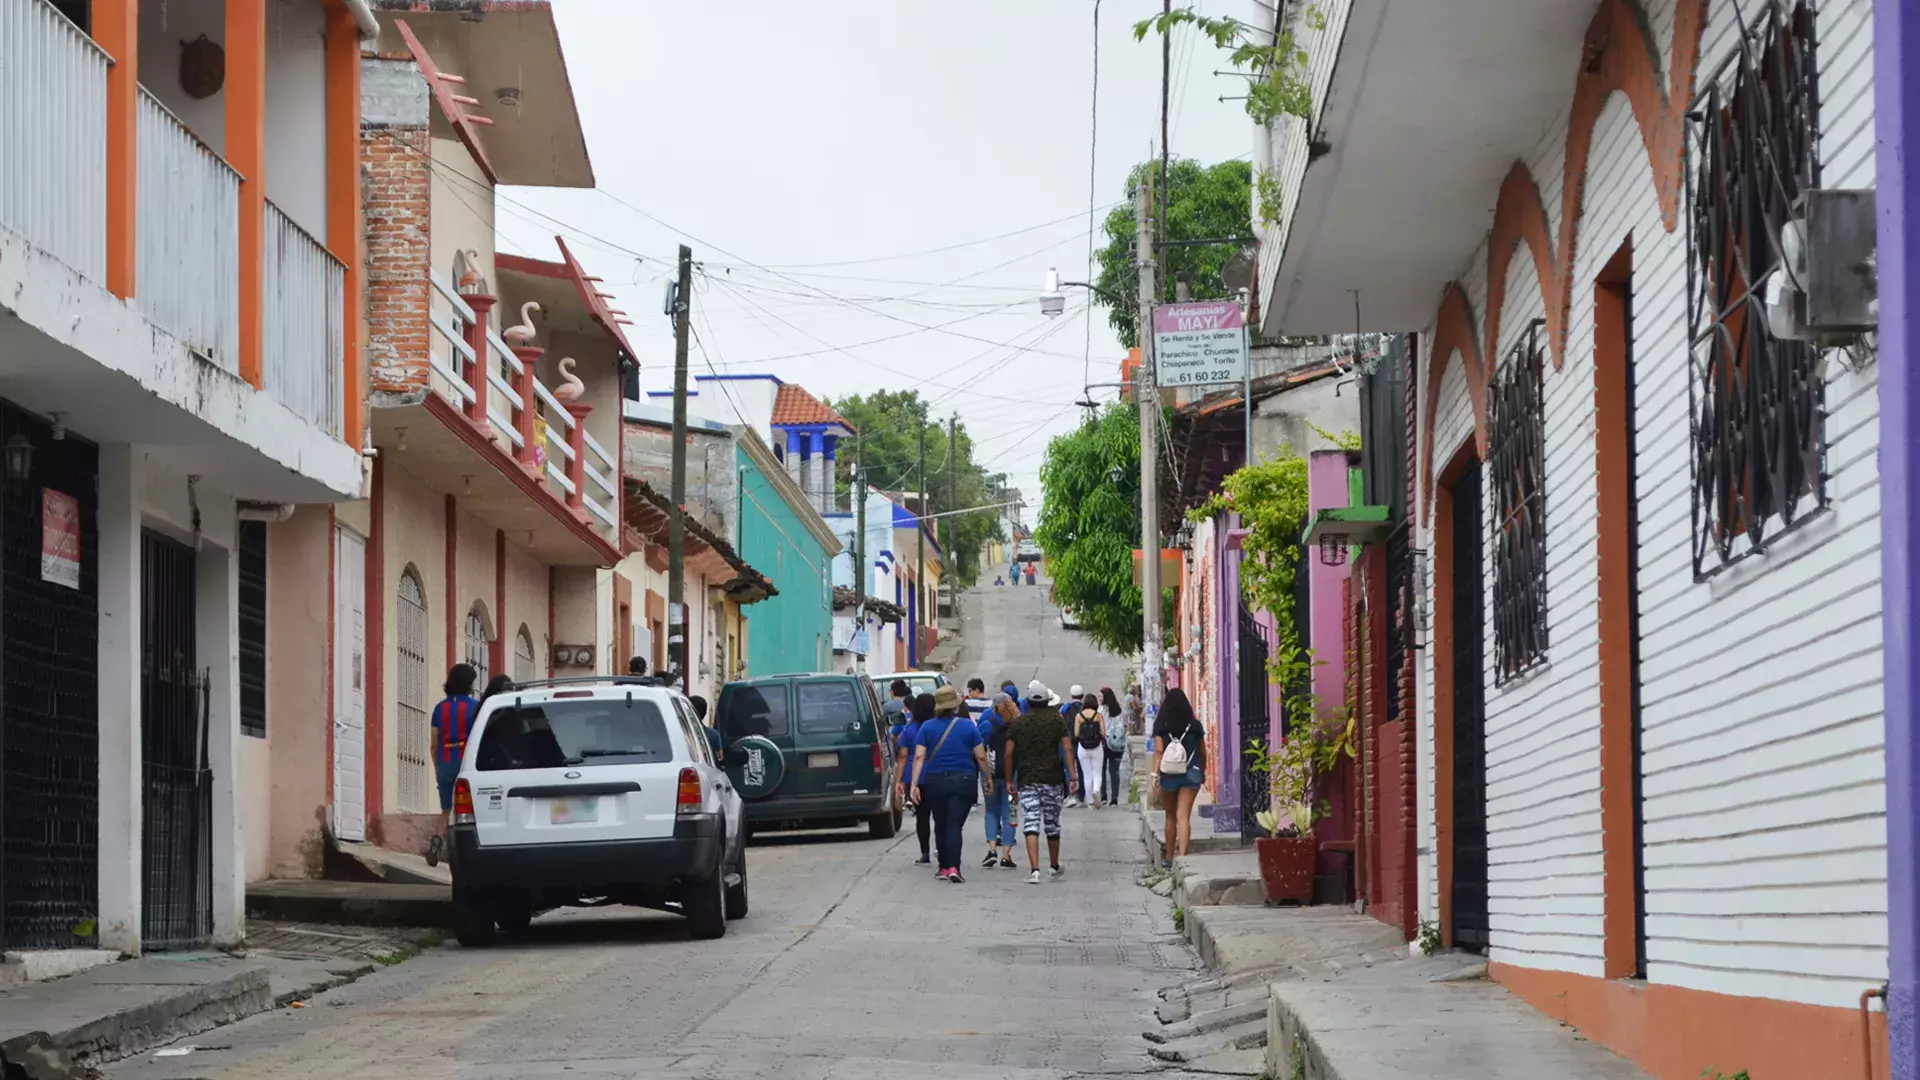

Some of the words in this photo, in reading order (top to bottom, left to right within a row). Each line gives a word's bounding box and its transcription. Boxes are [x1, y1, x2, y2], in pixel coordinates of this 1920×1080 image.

[1178, 316, 1218, 330] MAYI
[1204, 348, 1239, 356] Chuntaes
[1180, 373, 1191, 382] 61
[1195, 371, 1208, 381] 60
[1211, 370, 1230, 380] 232
